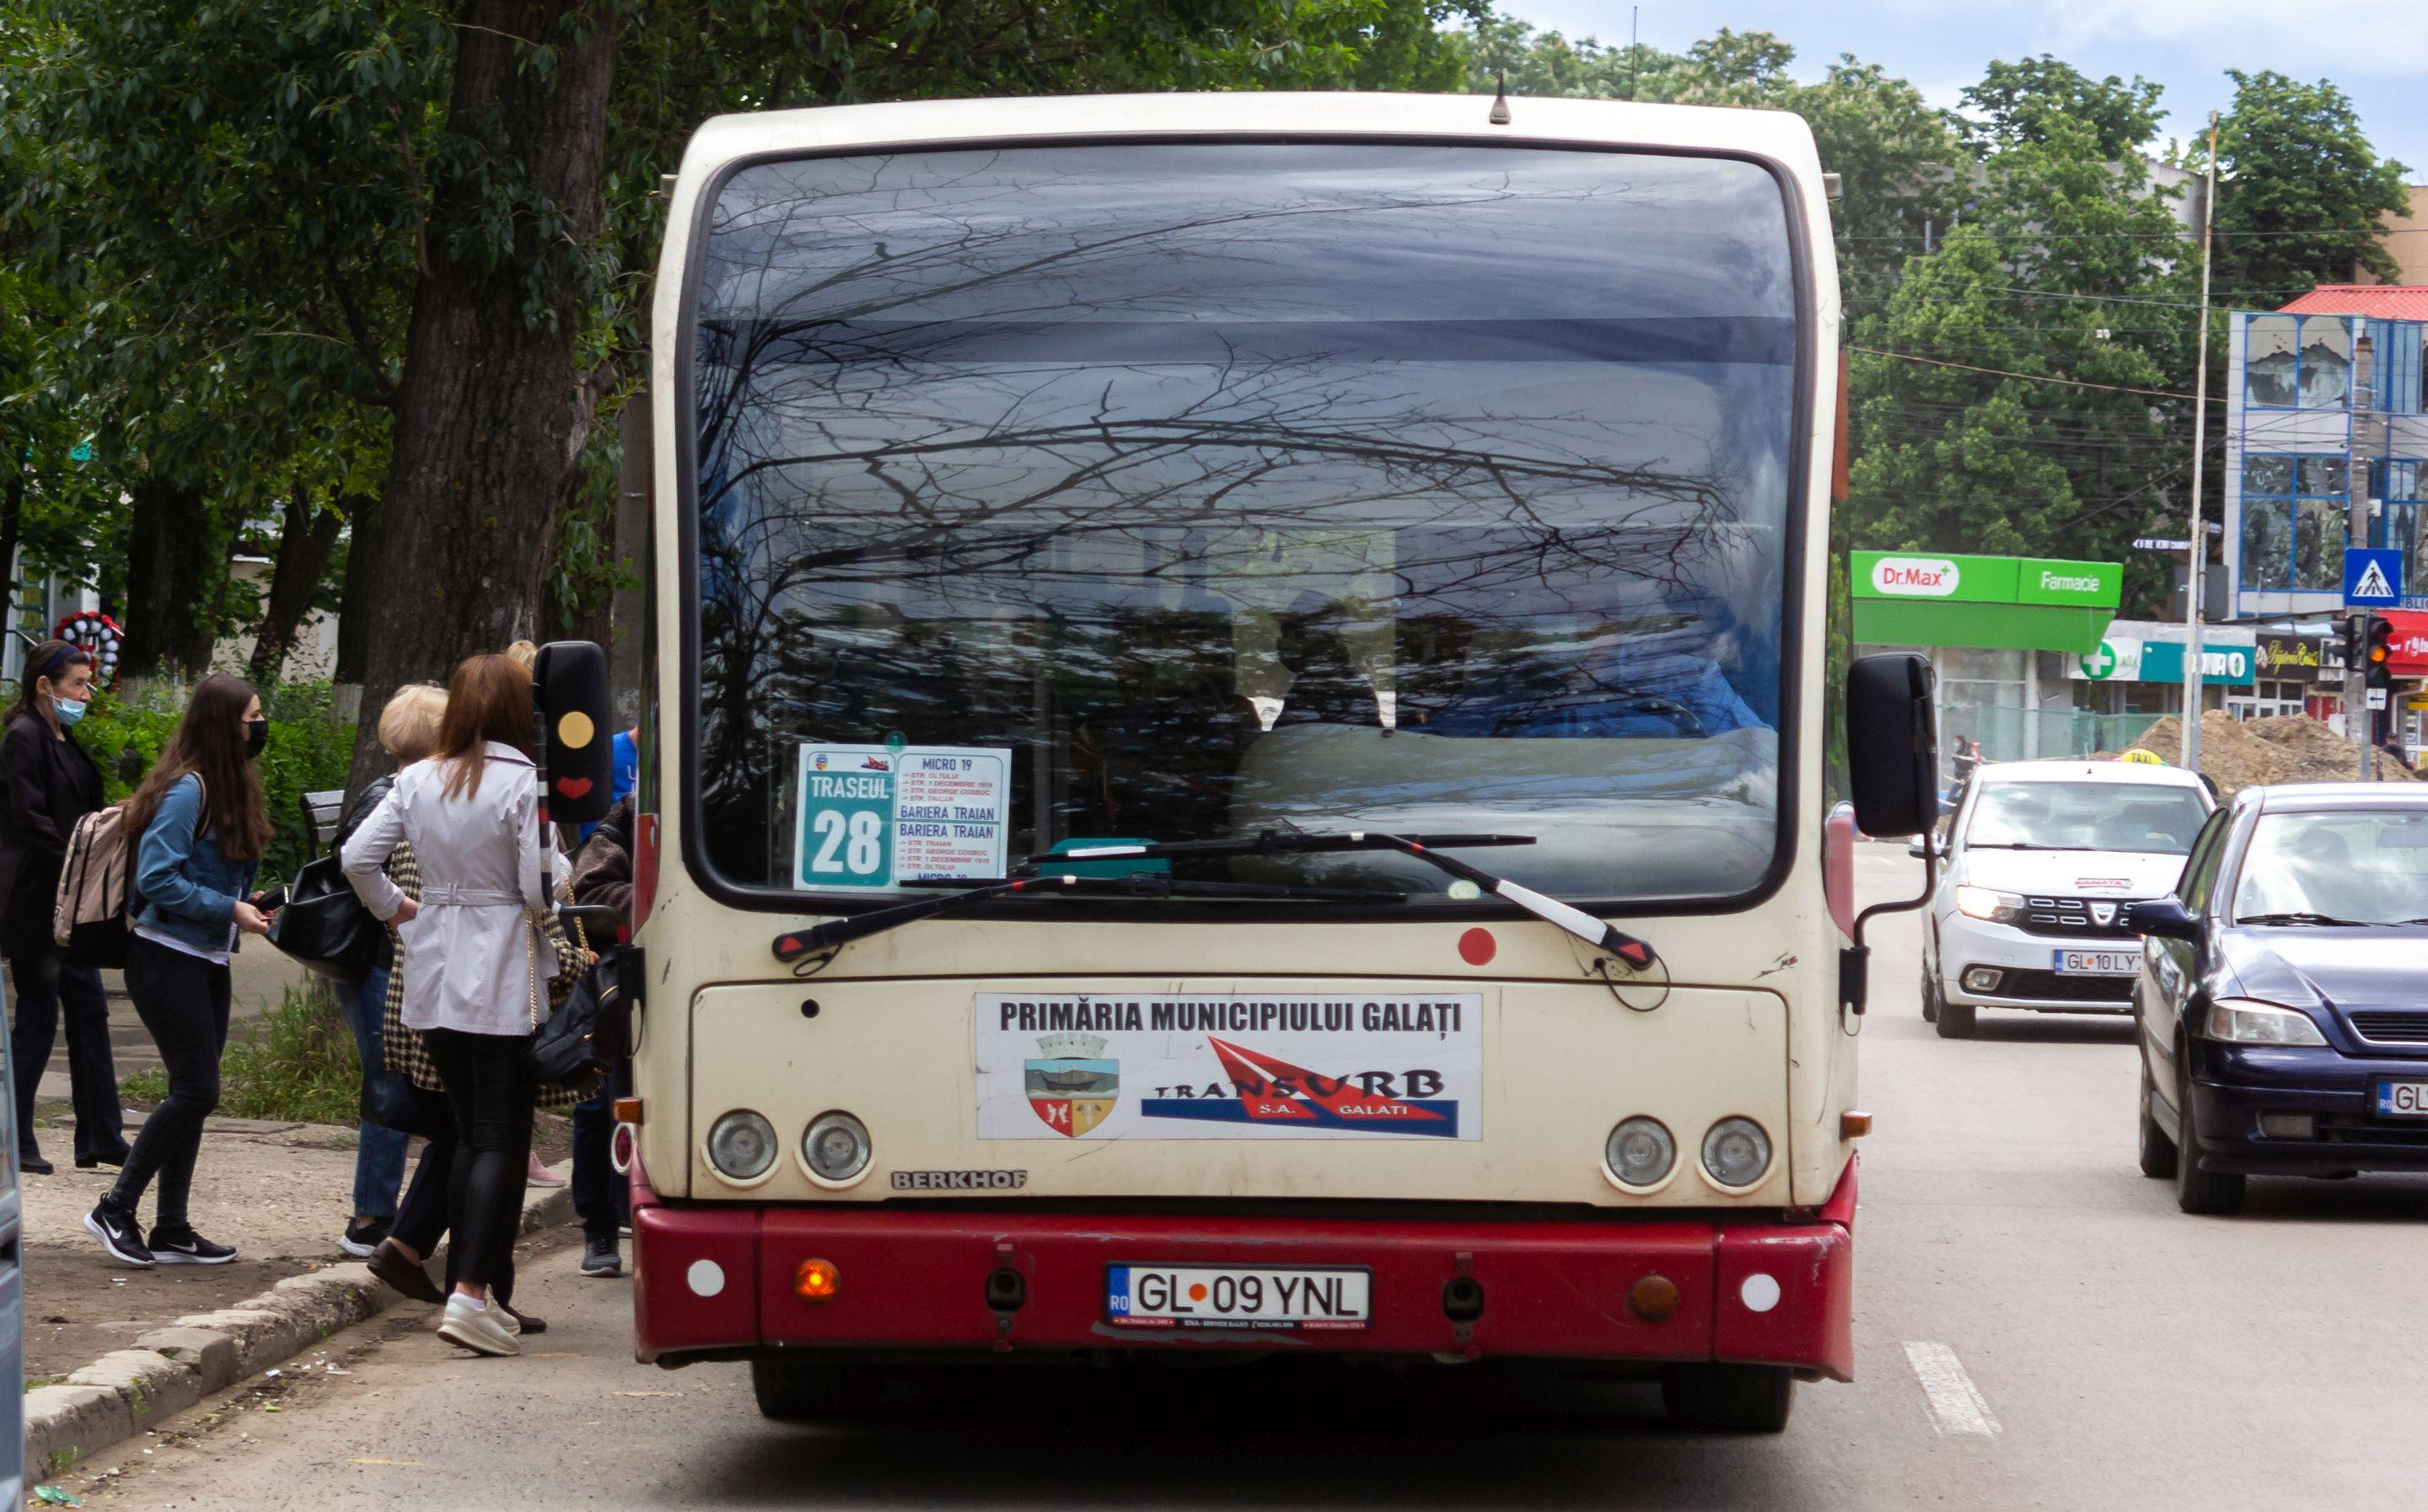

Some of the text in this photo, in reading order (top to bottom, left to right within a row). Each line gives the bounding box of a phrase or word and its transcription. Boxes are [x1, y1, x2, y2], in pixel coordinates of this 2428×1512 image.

[1883, 567, 1942, 587] Dr.Max
[2041, 571, 2100, 592] Farmacie
[922, 758, 972, 771] MICRO 19
[2131, 753, 2151, 764] TAXI
[811, 776, 889, 799] TRASEUL
[900, 805, 994, 820] BARIERA TRAIAN
[900, 823, 993, 839] BARIERA TRAIAN
[813, 809, 882, 875] 28
[2067, 954, 2088, 969] GL
[2095, 955, 2111, 970] 10
[2114, 955, 2141, 971] LY
[1000, 996, 1463, 1041] PRIMĂRIA MUNICIPIULUI GALAȚI
[1155, 1069, 1445, 1099] TRANSURB
[1260, 1104, 1409, 1115] S.A. GALATI
[2379, 1098, 2393, 1110] RO
[892, 1171, 1028, 1189] BERKHOF
[1109, 1295, 1129, 1311] RO
[1138, 1273, 1359, 1316] GL 09 YNL
